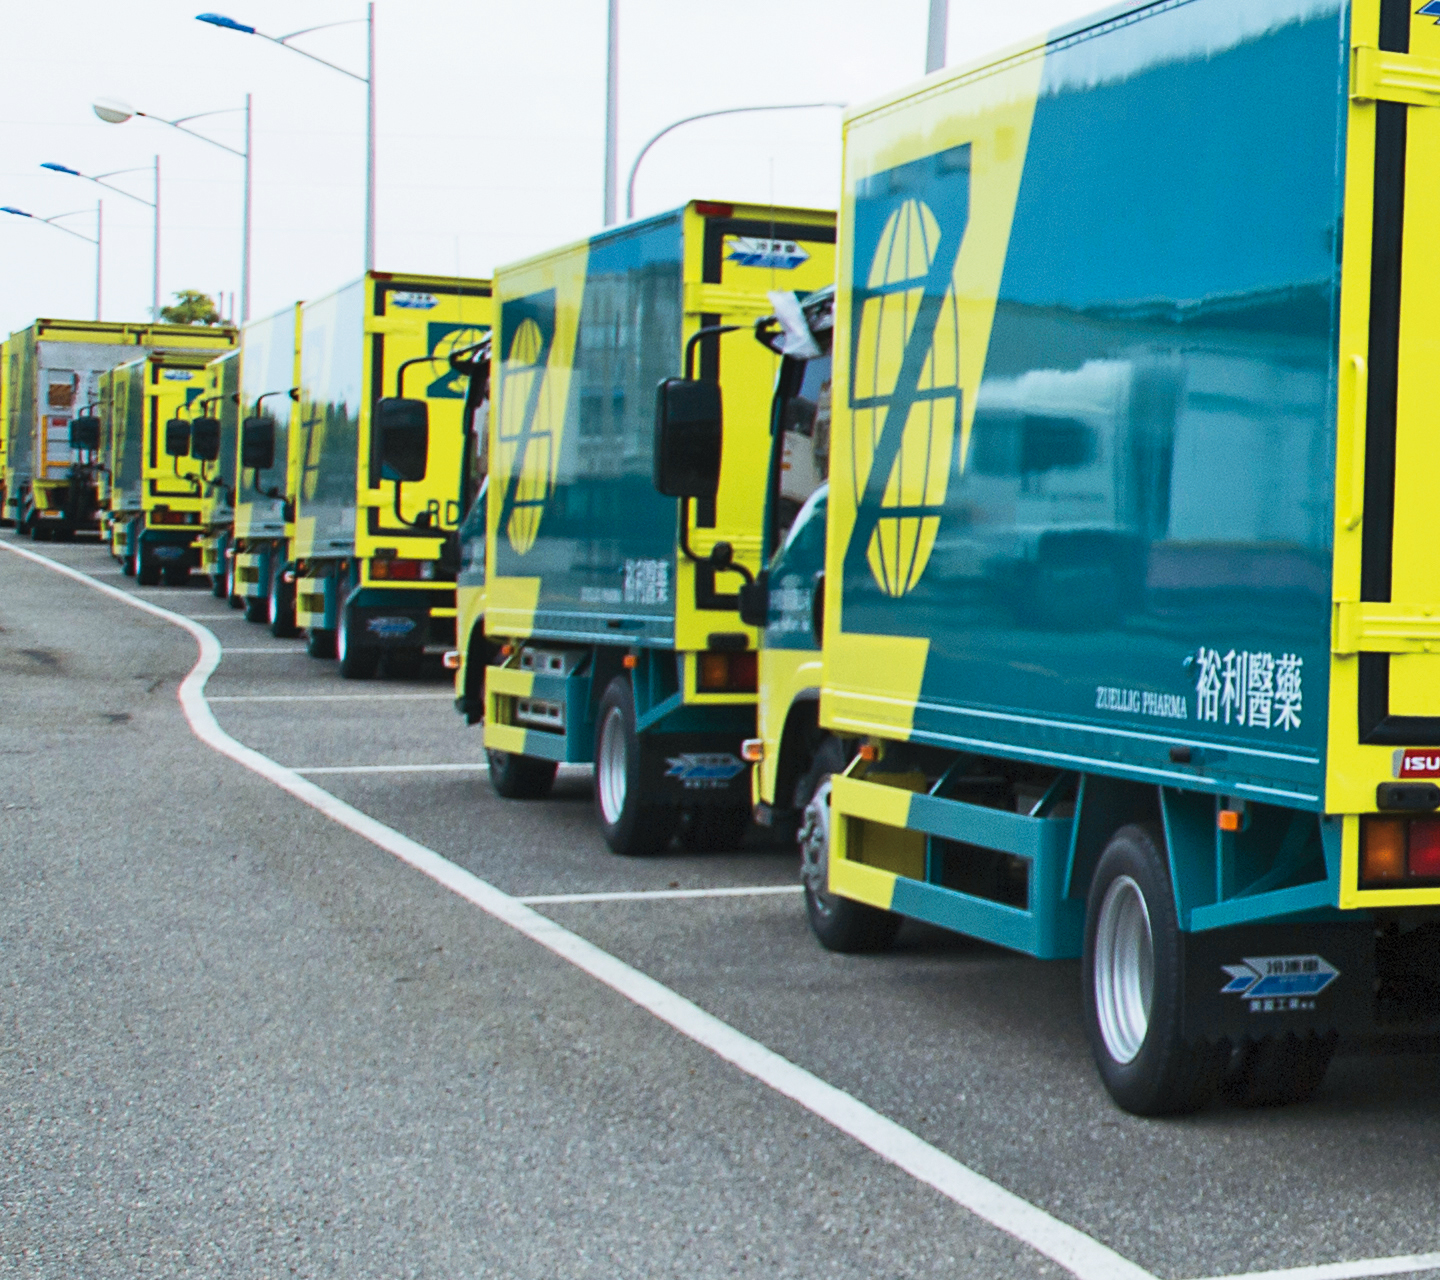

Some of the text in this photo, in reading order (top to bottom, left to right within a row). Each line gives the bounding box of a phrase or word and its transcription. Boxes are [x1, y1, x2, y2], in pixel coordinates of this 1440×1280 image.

[1096, 685, 1188, 720] ZUELLIG PHARMA
[1196, 646, 1304, 732] 裕利醫藥
